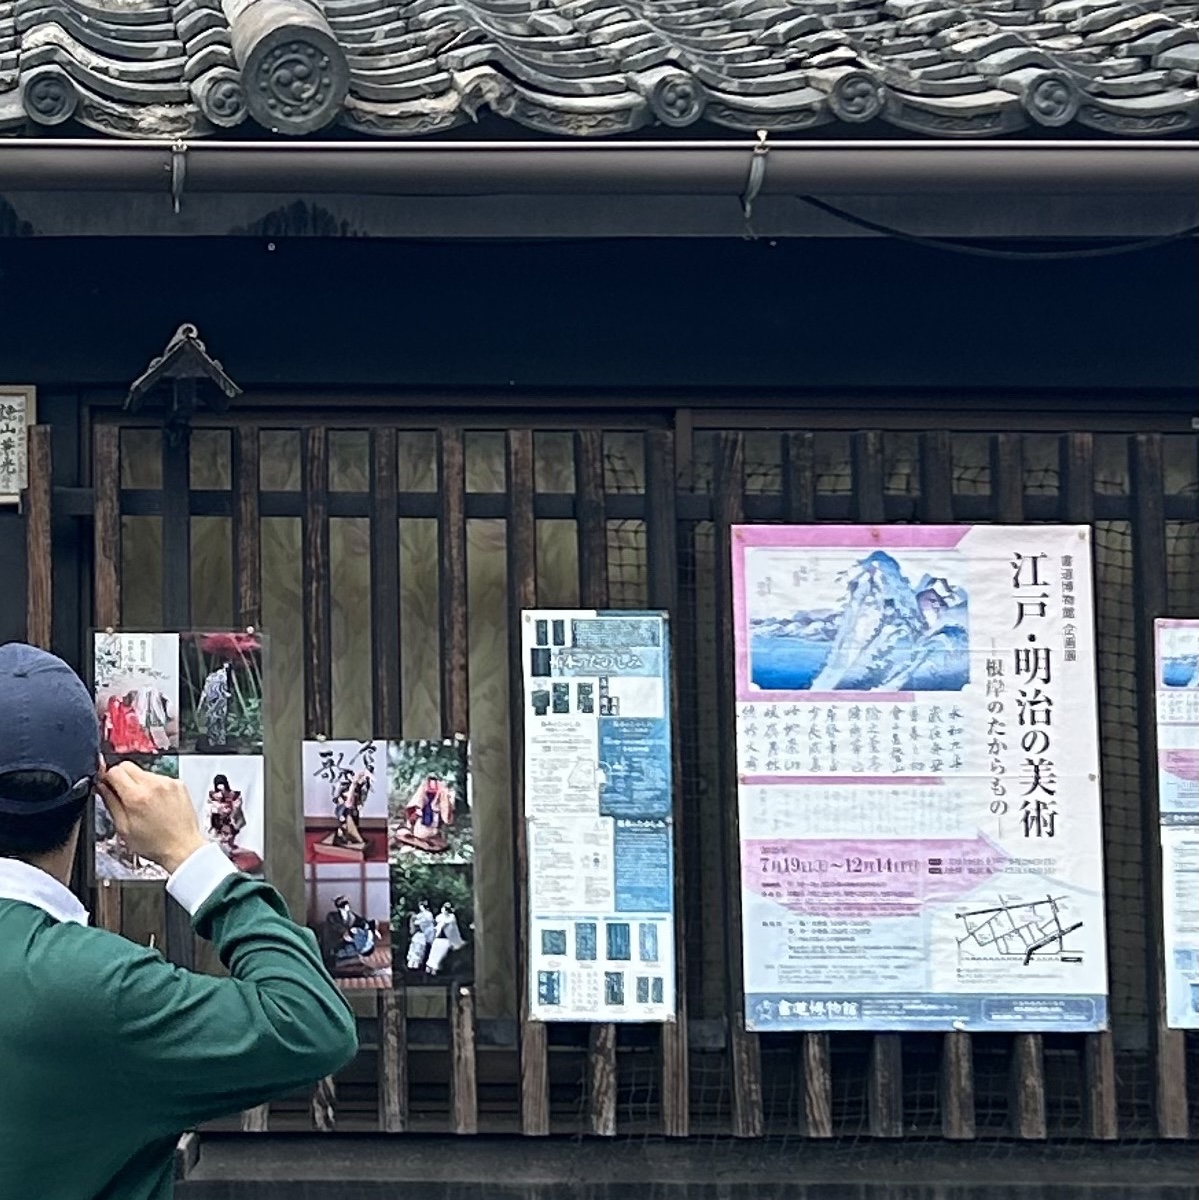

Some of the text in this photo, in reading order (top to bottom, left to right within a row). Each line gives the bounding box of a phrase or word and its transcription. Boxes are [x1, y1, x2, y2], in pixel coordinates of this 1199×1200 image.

[1011, 551, 1059, 838] 江戸・明治の美術
